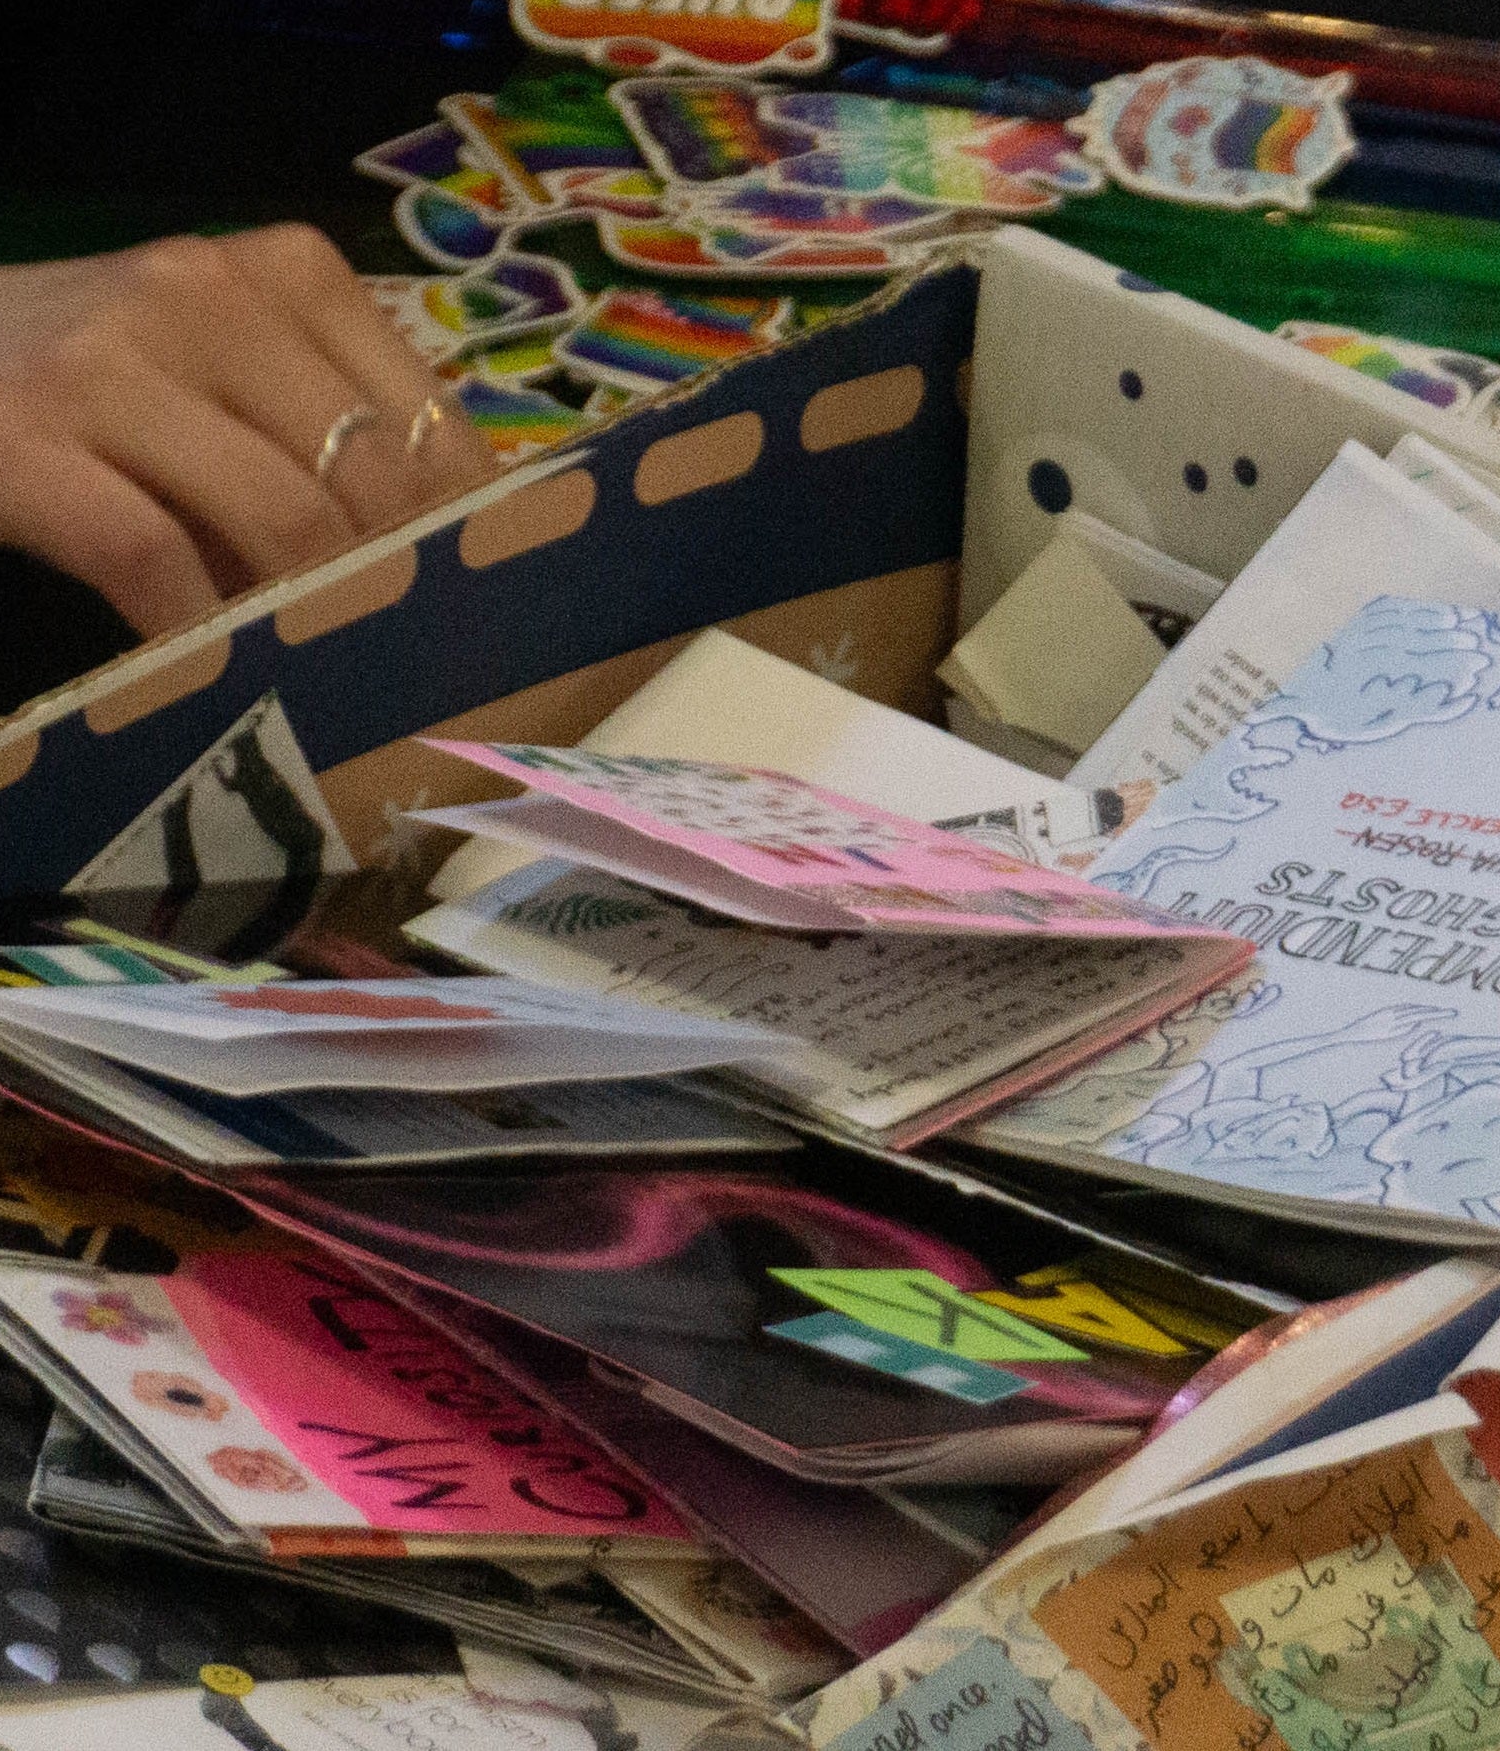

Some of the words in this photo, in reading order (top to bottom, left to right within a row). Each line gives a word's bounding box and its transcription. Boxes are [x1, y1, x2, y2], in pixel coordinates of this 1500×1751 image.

[1338, 790, 1411, 817] ESQ
[297, 1418, 485, 1512] MY
[929, 1681, 997, 1736] once.
